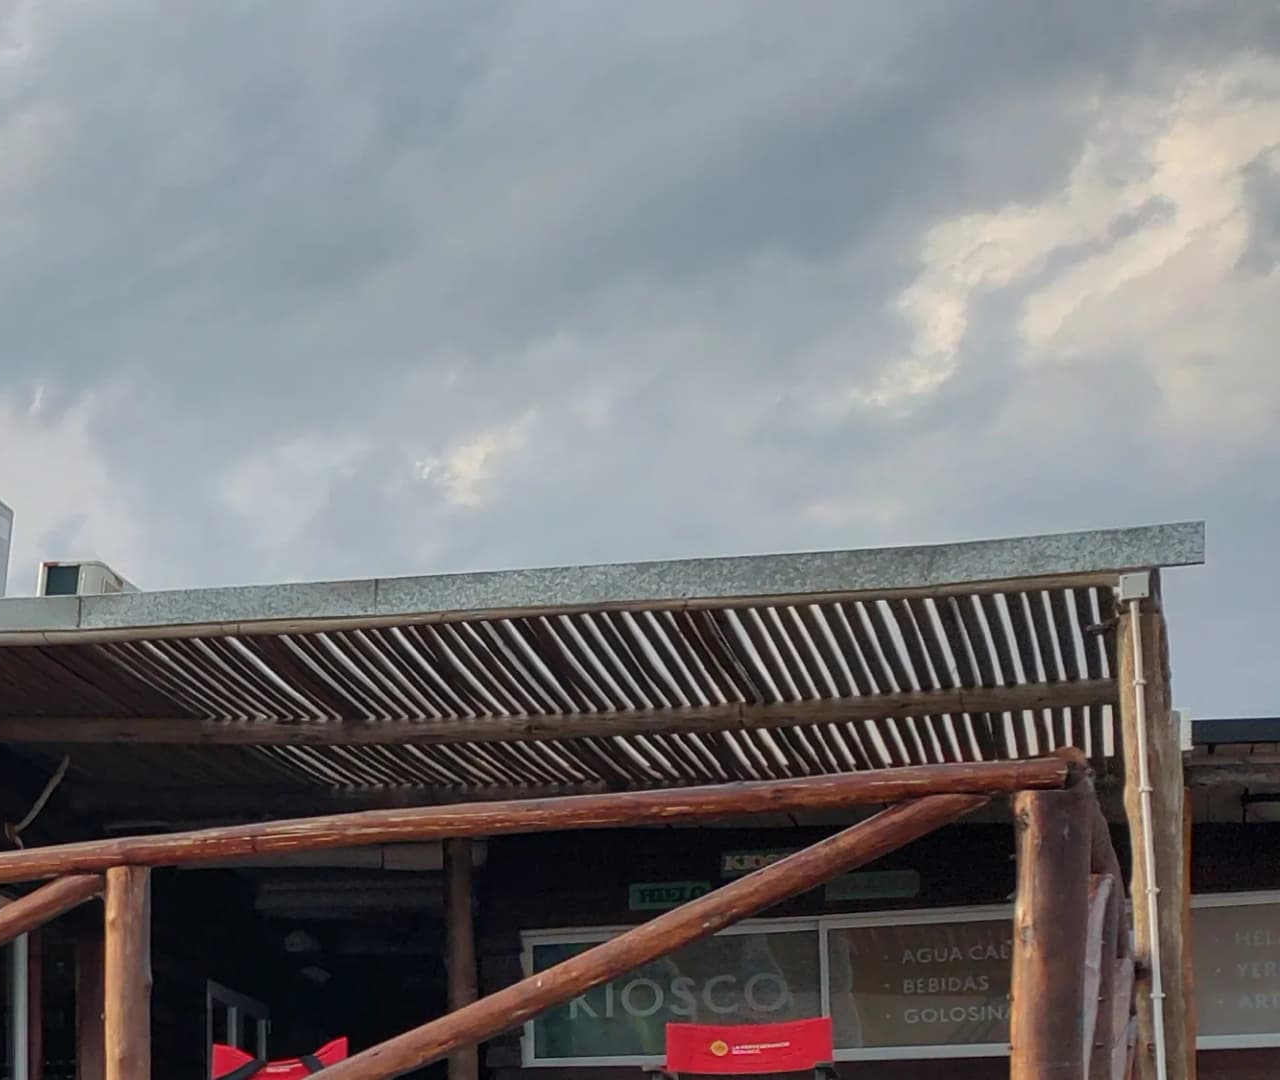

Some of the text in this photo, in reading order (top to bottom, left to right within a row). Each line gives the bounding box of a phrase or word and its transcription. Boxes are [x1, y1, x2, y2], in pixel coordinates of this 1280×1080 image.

[1234, 929, 1280, 945] HEL
[902, 944, 1010, 964] AGUA CAL
[1237, 961, 1280, 977] YER
[903, 975, 989, 994] BEBIDAS
